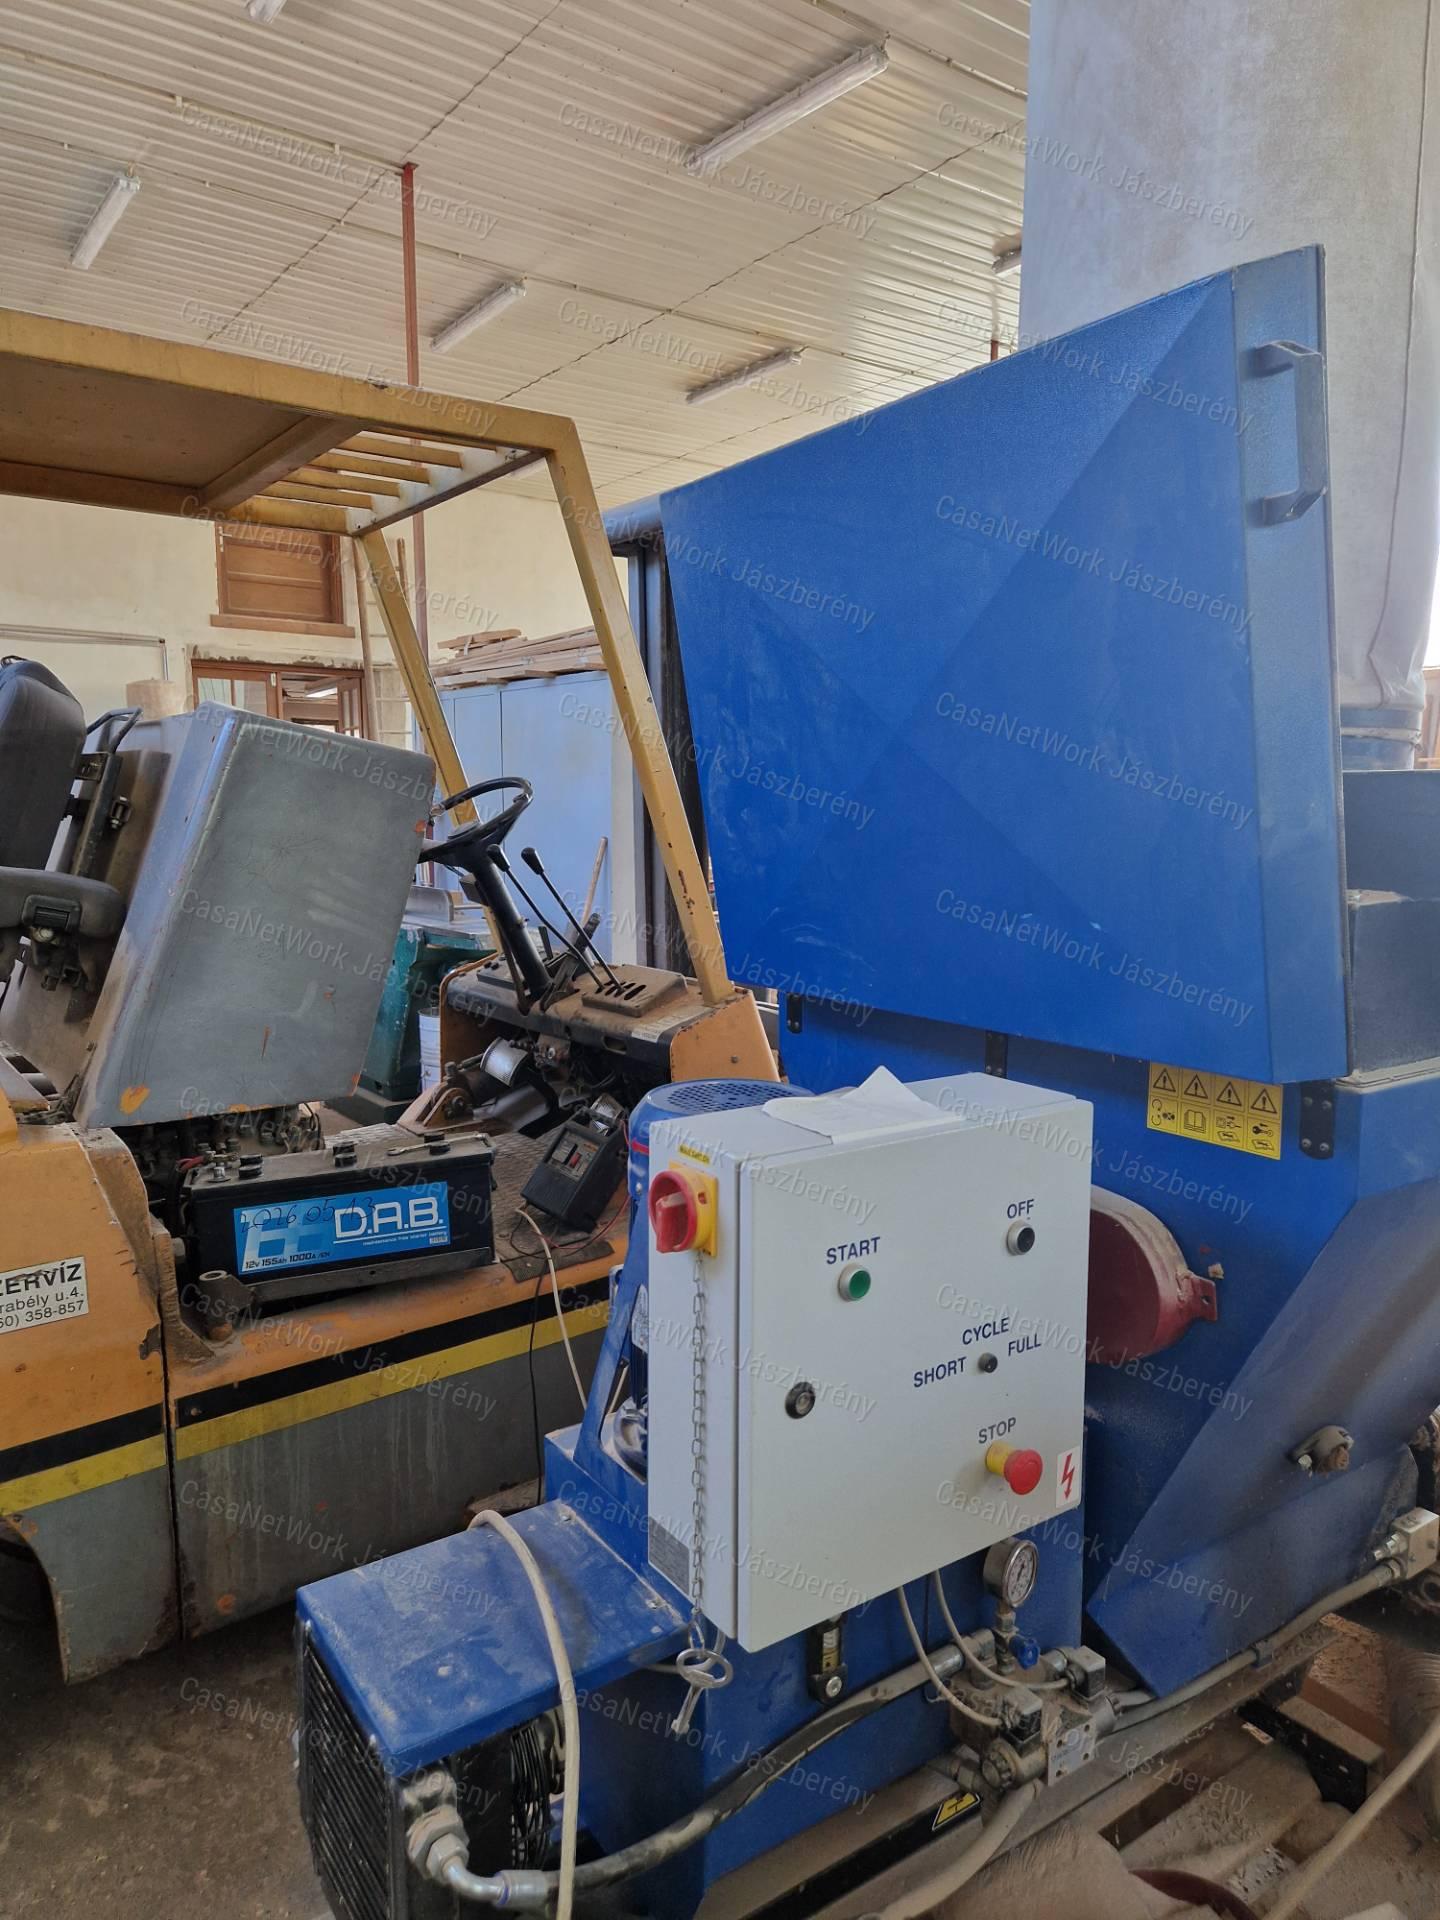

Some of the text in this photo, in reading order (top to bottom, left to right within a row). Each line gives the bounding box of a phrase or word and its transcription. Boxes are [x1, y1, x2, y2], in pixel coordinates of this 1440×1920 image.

[334, 1197, 444, 1239] D.A.B.
[1006, 1199, 1035, 1219] OFF
[826, 1236, 881, 1265] START
[0, 1261, 82, 1297] ERVÍZ
[25, 1300, 84, 1322] 358-857
[961, 1317, 1010, 1346] CYCLE
[1008, 1333, 1042, 1357] FULL
[913, 1356, 967, 1388] SHORT
[978, 1417, 1017, 1445] STOP
